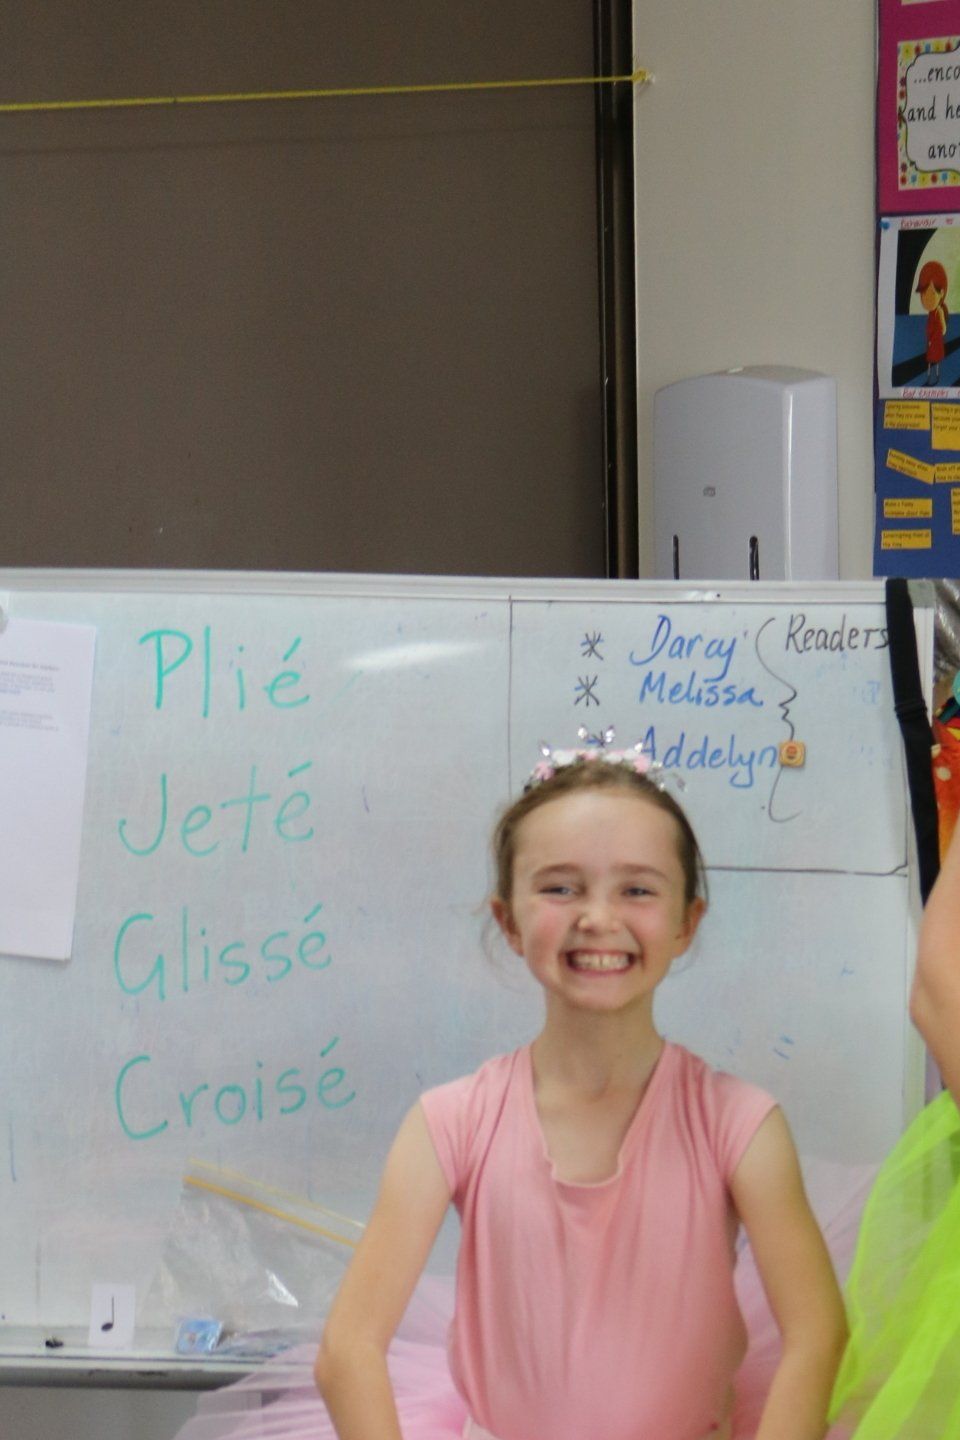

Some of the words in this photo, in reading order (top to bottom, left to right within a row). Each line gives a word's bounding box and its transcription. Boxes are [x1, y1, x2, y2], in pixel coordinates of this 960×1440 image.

[907, 94, 937, 122] and
[139, 625, 311, 719] Plié
[629, 614, 738, 682] Darcy
[786, 614, 889, 655] Readers
[639, 671, 764, 706] Melissa
[642, 726, 778, 789] Addelyn
[118, 761, 314, 857] Jeté
[114, 903, 332, 1001] Glissé
[115, 1037, 356, 1140] Croisé
